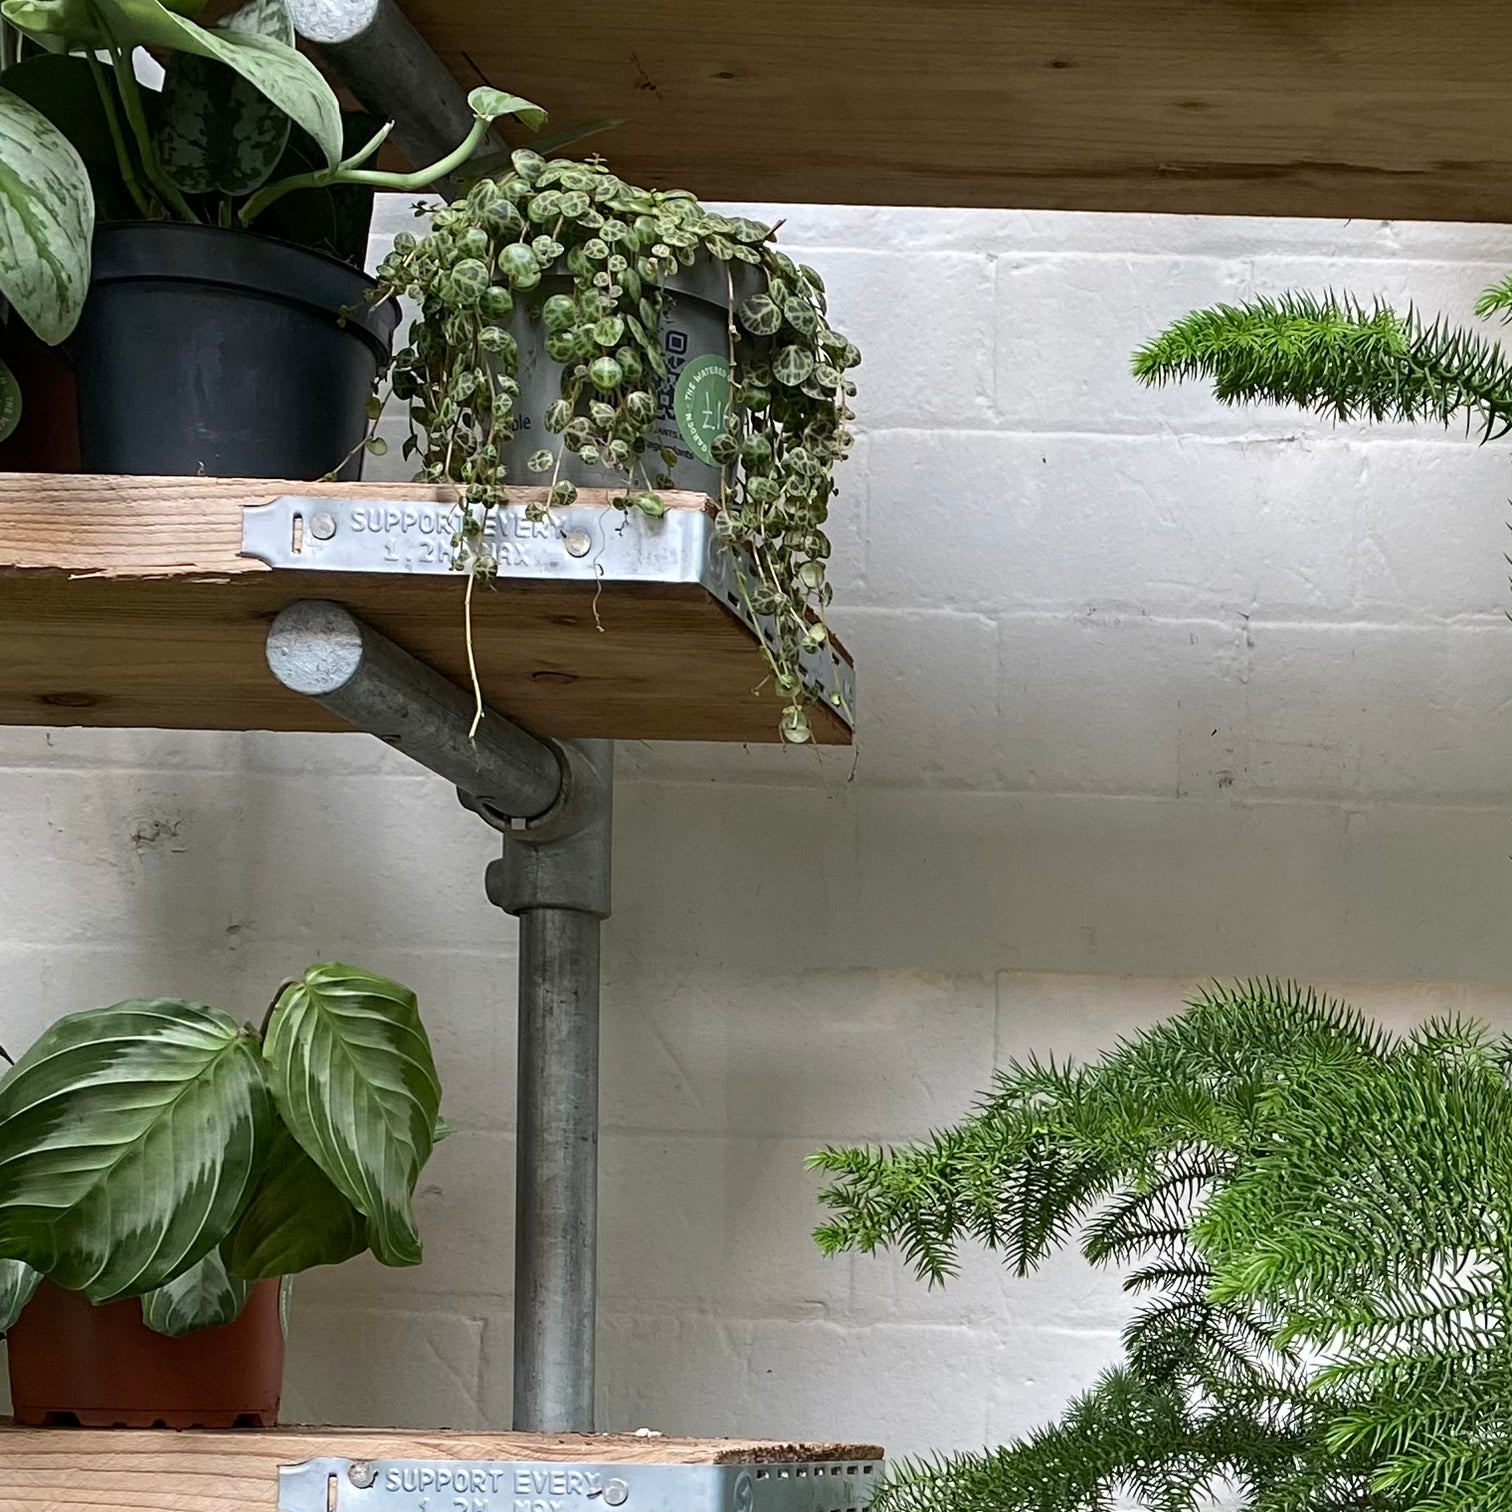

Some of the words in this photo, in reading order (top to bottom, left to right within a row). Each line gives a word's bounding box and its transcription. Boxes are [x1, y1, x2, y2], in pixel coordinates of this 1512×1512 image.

[692, 365, 727, 383] WATERED
[684, 381, 697, 401] THE
[685, 412, 708, 452] GARDEN
[385, 1467, 504, 1494] SUPPORT
[513, 1469, 601, 1496] EVERY
